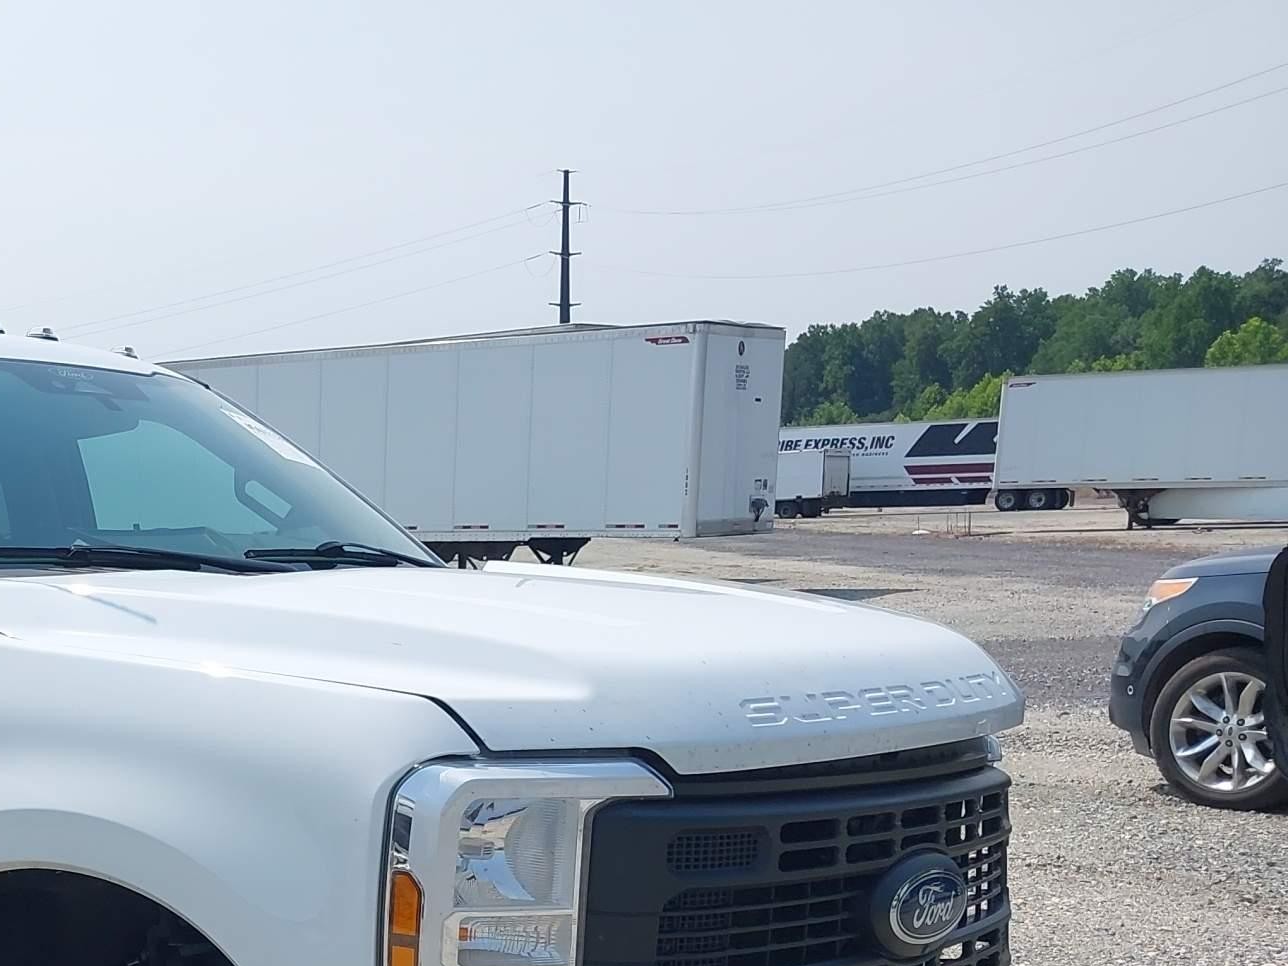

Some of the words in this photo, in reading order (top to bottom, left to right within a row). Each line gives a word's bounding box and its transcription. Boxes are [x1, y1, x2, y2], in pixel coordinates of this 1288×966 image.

[778, 439, 802, 451] IBE
[739, 685, 926, 727] SUPER
[920, 671, 1007, 707] DUTY
[913, 881, 956, 929] Ford
